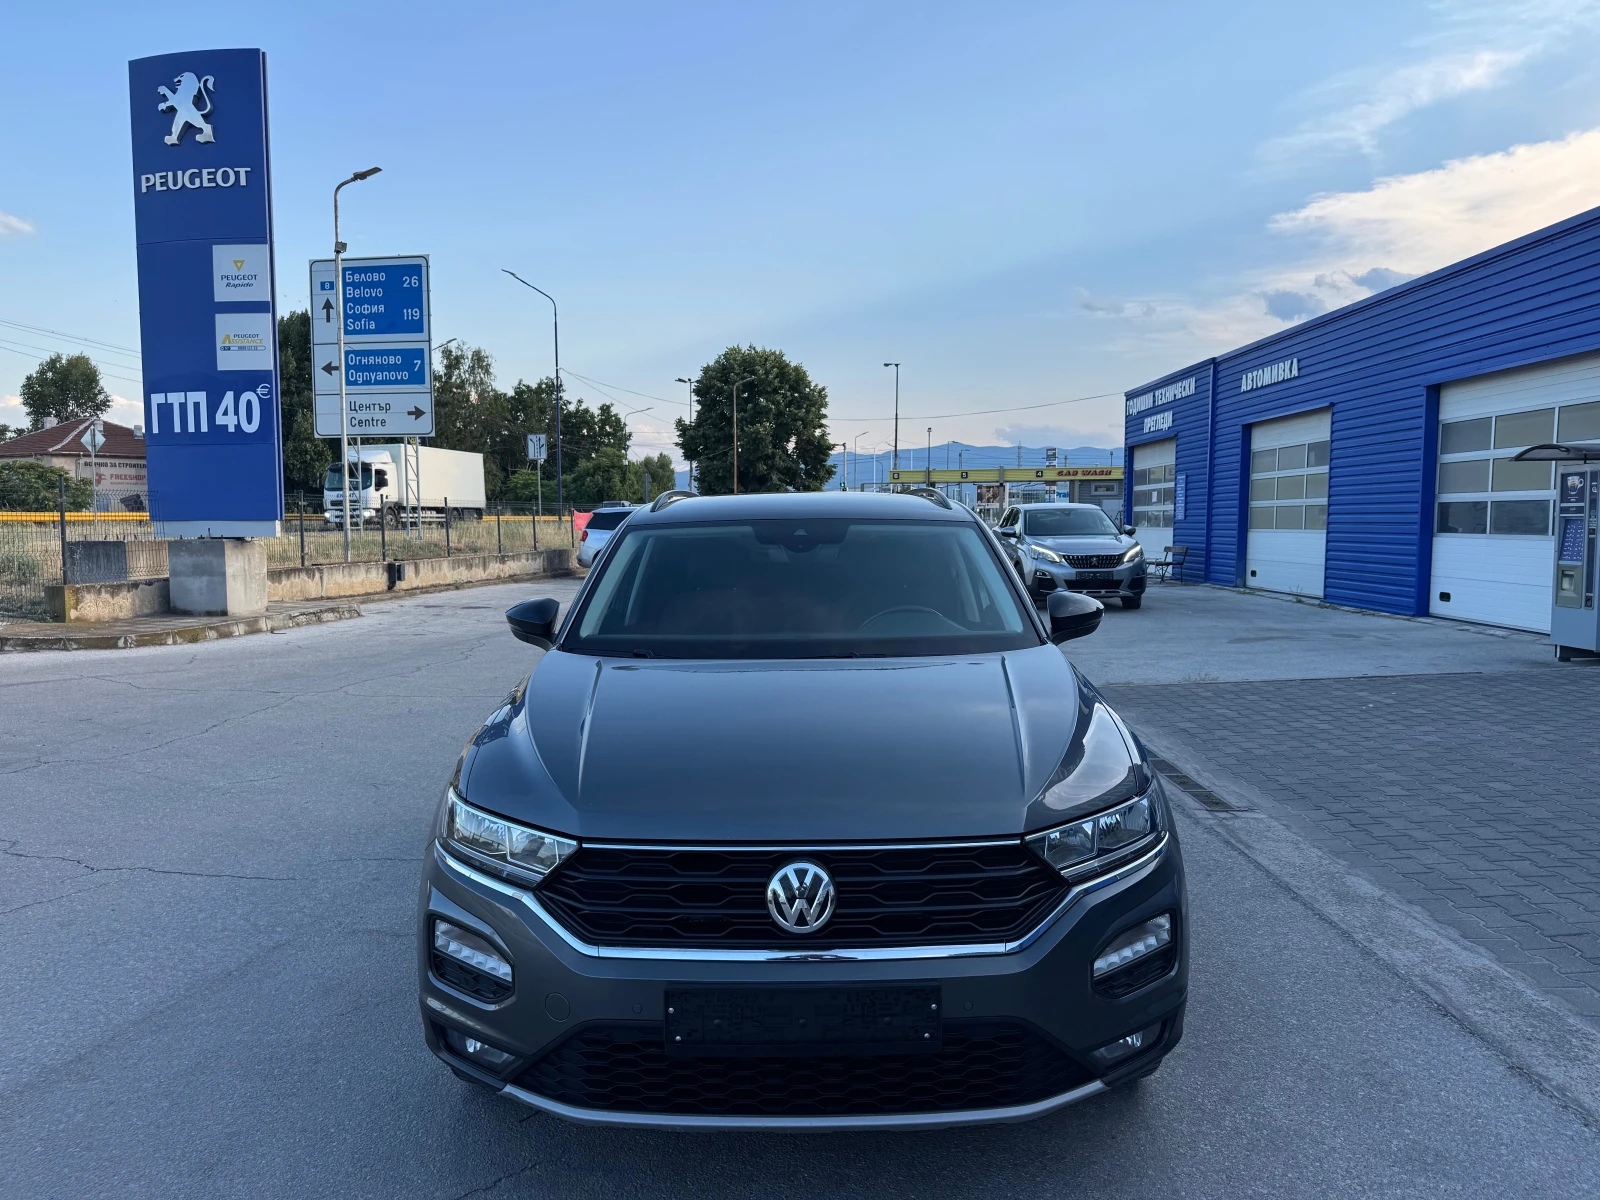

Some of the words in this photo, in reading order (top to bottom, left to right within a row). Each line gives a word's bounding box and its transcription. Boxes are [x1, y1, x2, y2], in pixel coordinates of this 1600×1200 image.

[141, 167, 251, 193] PEUGEOT
[324, 282, 330, 290] 8
[345, 271, 386, 282] Белово
[402, 276, 419, 288] 26
[346, 286, 383, 298] Belovo
[346, 302, 385, 315] София
[403, 308, 420, 320] 119
[347, 318, 376, 330] Sofia
[348, 353, 402, 366] Огняново
[413, 360, 421, 372] 7
[348, 370, 409, 383] Ognyanovo
[1240, 357, 1299, 393] АВТОМИВКА
[1155, 376, 1196, 406] ТЕХНИЧЕСКИ
[150, 391, 208, 434] ГТП
[349, 400, 391, 414] Център
[350, 416, 387, 428] Centre
[1143, 410, 1173, 434] ПРЕГЛЕДИ
